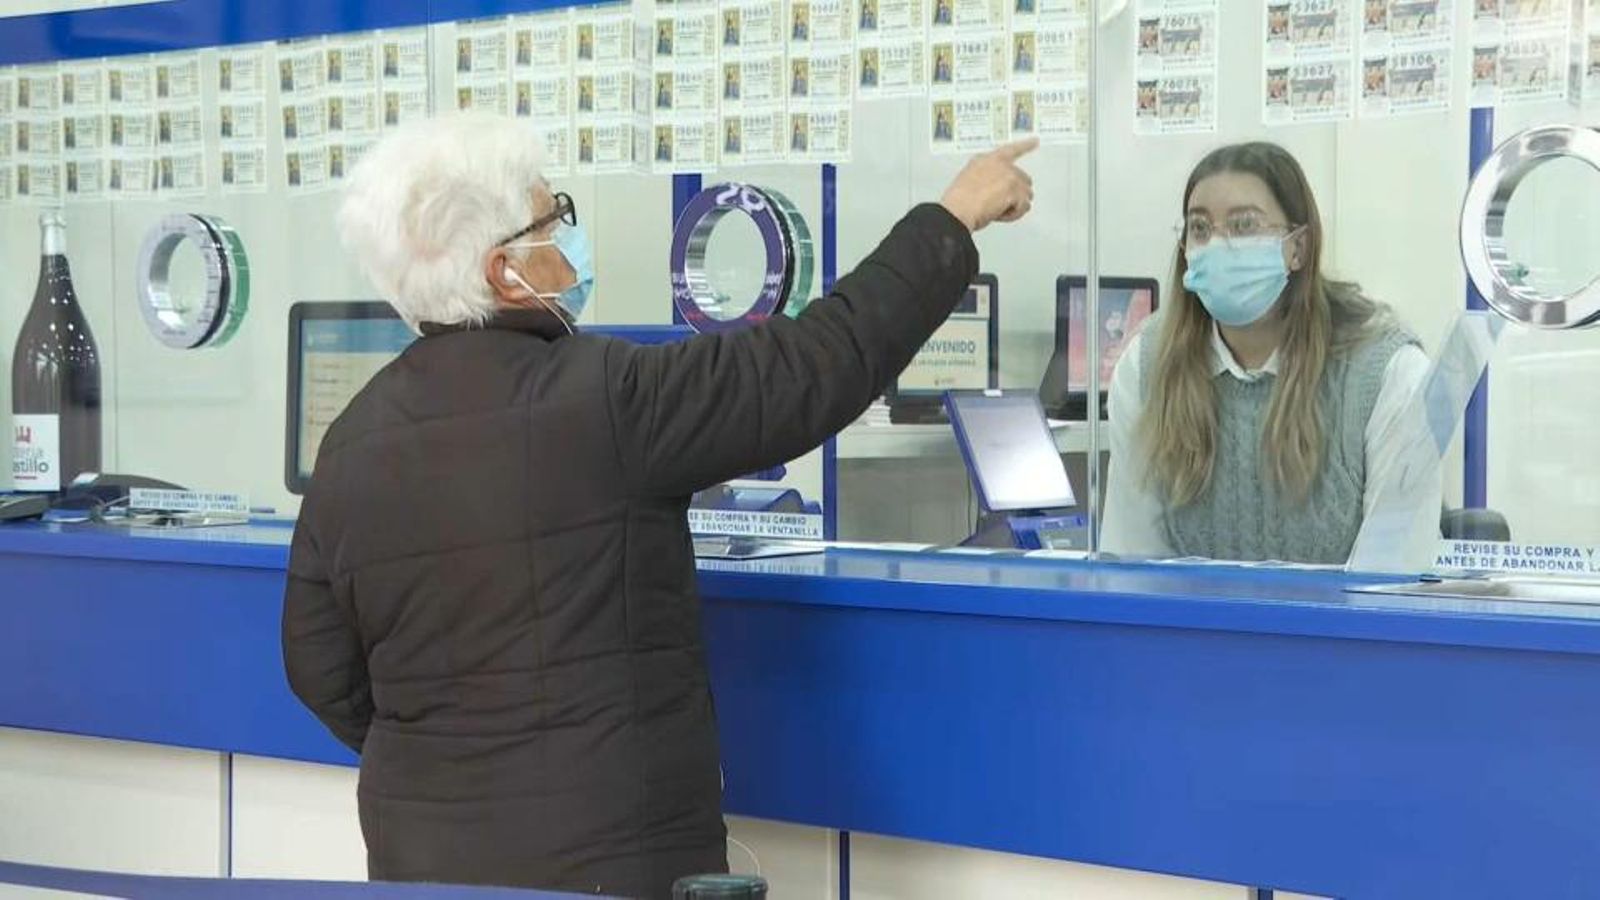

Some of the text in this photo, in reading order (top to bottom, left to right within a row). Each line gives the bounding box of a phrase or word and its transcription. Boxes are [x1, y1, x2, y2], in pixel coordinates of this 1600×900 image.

[715, 513, 750, 522] COMPRA
[760, 515, 771, 523] SU
[774, 516, 806, 525] CAMBIO
[701, 522, 750, 532] ABANDONAR
[767, 525, 819, 535] VENTANILLA
[1453, 543, 1595, 558] REVISE SU COMPRA Y
[1436, 556, 1476, 566] ANTES
[1480, 556, 1498, 567] DE
[1502, 558, 1584, 570] ABANDONAR
